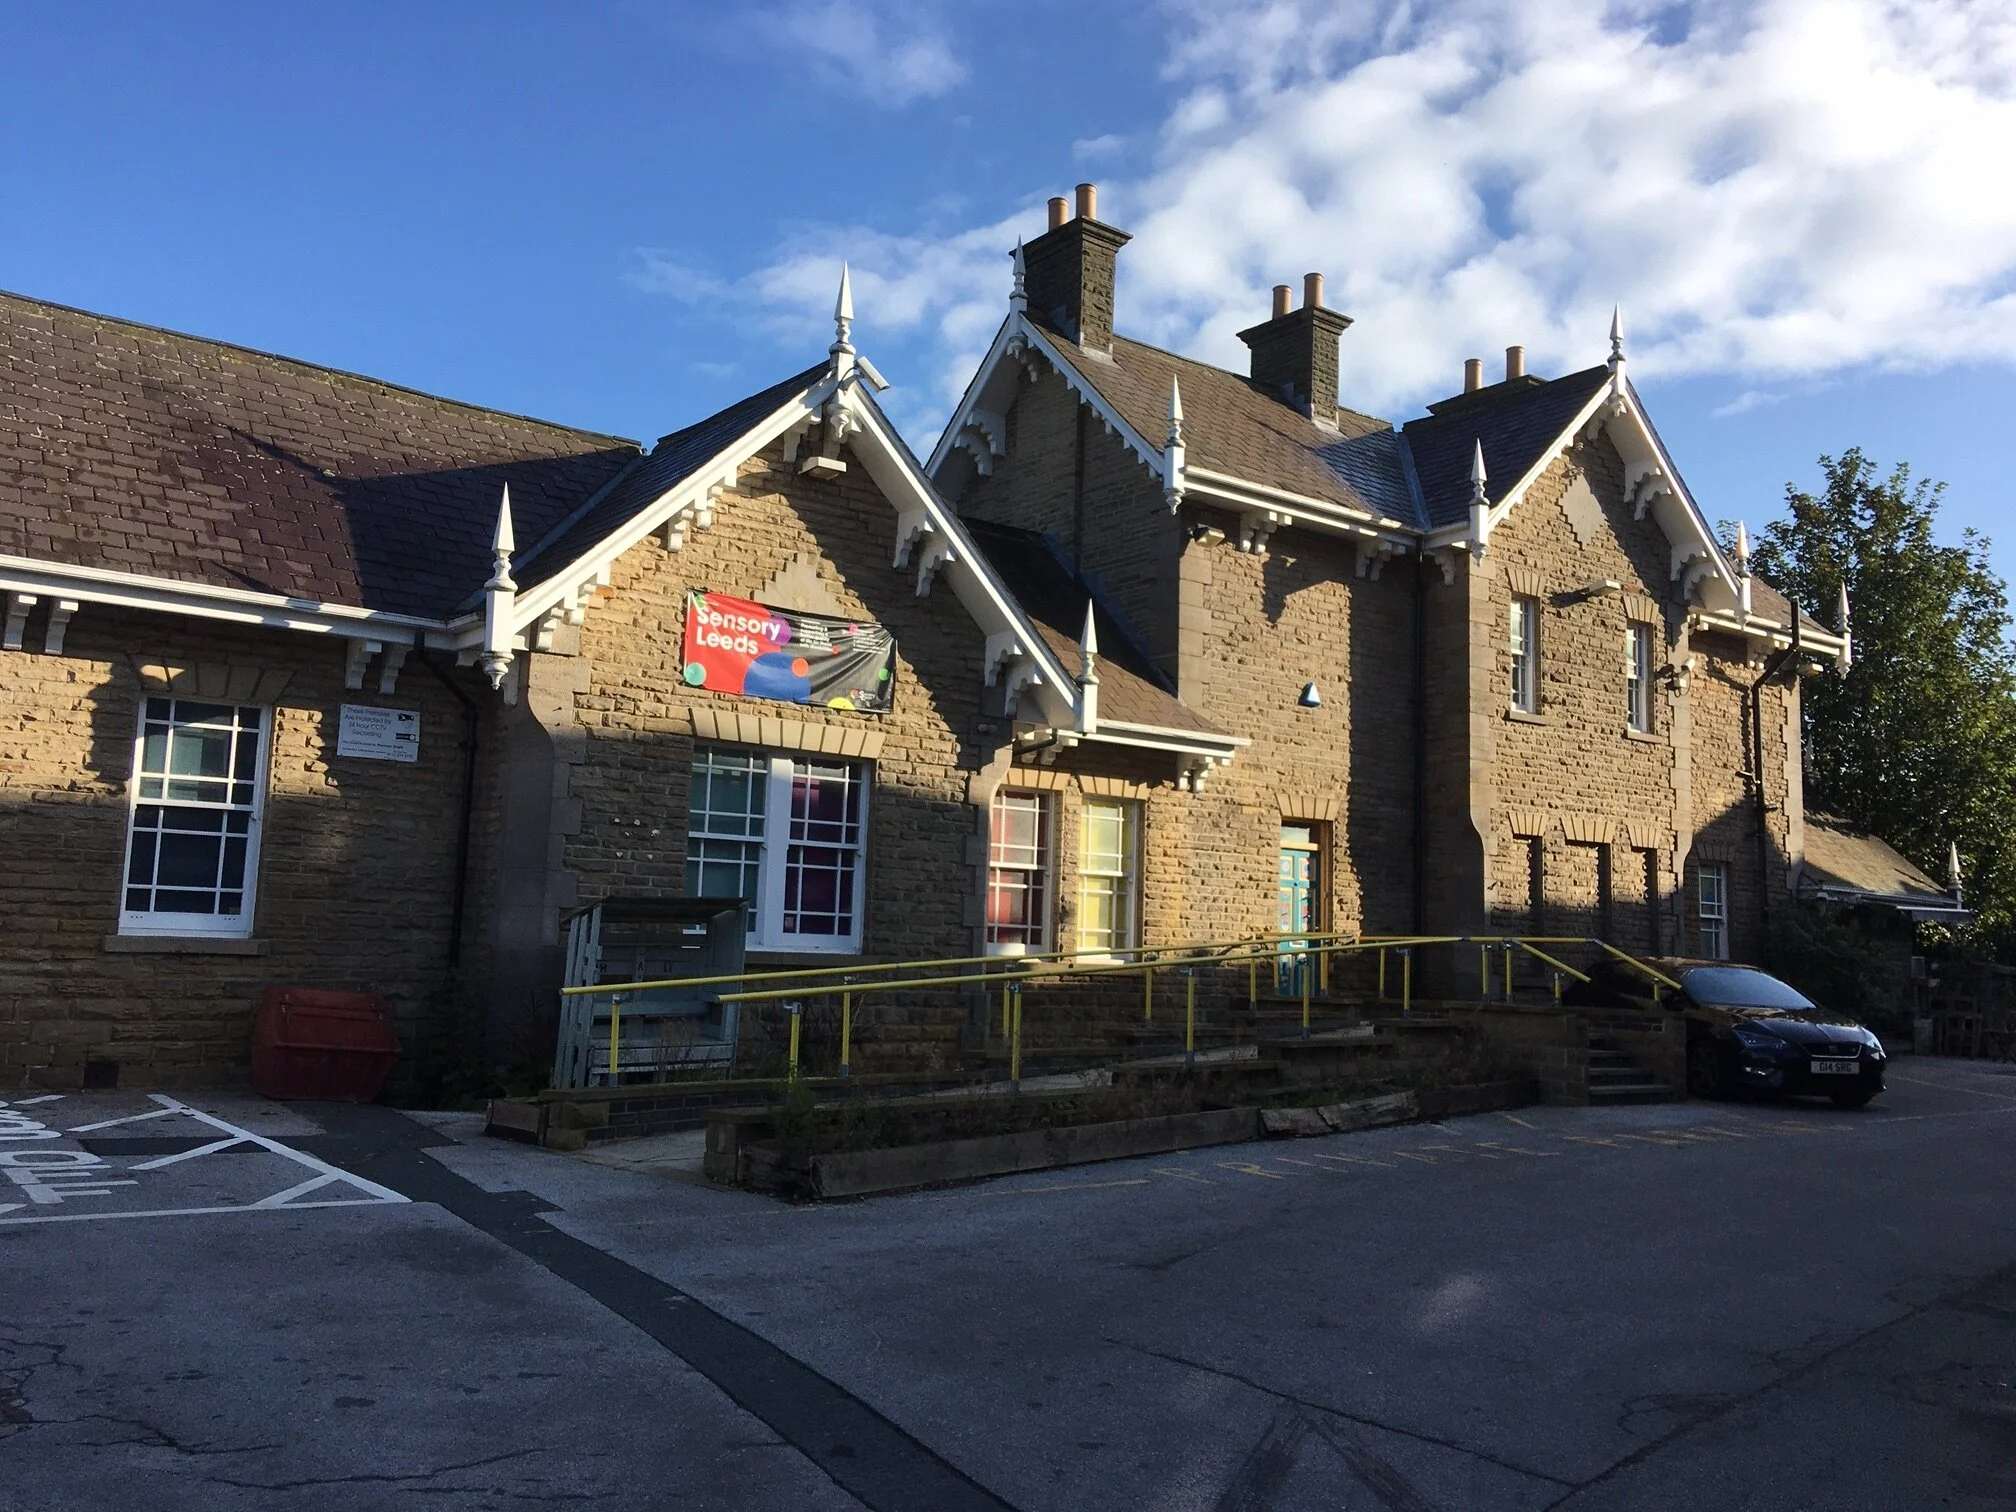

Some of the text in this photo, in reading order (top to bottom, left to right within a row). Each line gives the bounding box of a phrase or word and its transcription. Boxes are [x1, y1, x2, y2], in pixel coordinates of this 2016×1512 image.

[697, 607, 781, 641] Sensory
[696, 626, 759, 655] Leeds
[347, 707, 390, 717] These Premises
[355, 715, 384, 724] Protected
[352, 729, 382, 739] Recording
